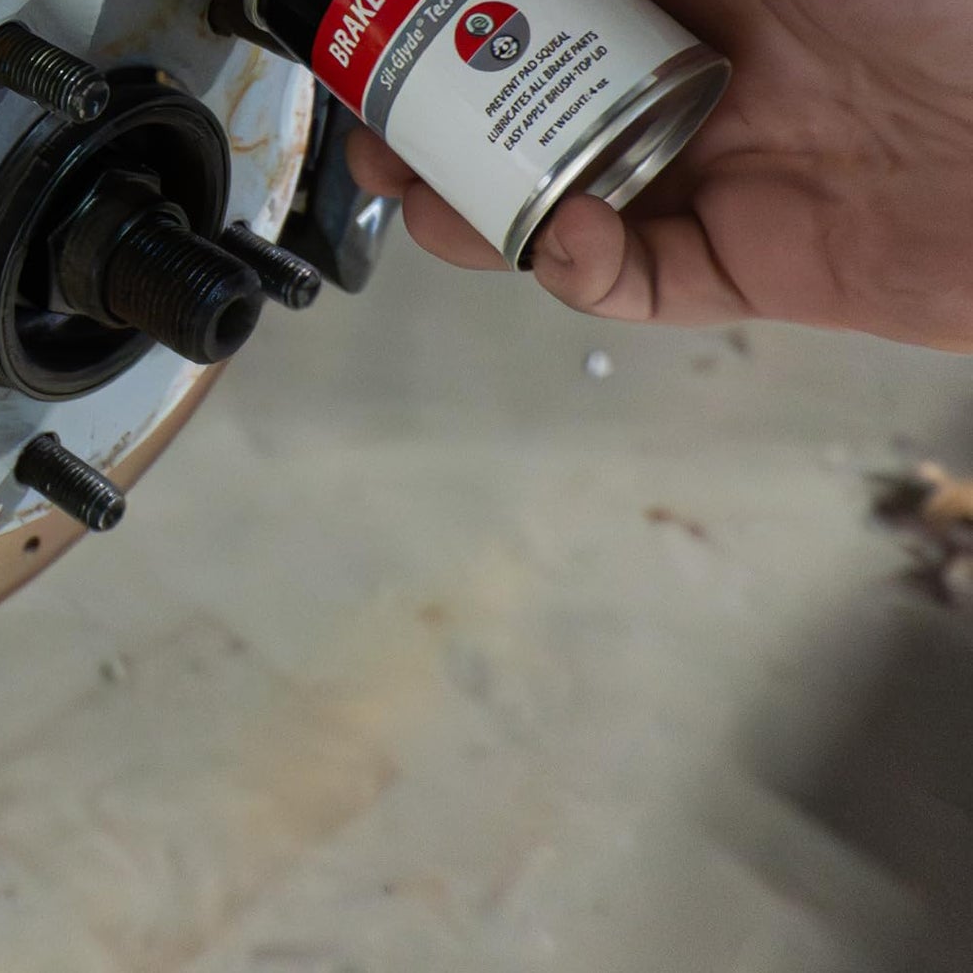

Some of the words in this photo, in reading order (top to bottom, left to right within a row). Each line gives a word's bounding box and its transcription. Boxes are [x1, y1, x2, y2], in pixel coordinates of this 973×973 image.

[485, 75, 521, 117] PREVENT
[518, 59, 538, 80] PAD
[535, 31, 571, 64] SQUEAL
[487, 91, 532, 143] LUBRICATES
[529, 77, 547, 96] ALL
[542, 50, 574, 80] BRAKE
[570, 30, 599, 55] PARTS
[503, 126, 525, 151] EASY
[522, 99, 547, 131] APPLY
[545, 57, 592, 104] BRUSH-TOP
[589, 45, 608, 62] LID
[538, 126, 557, 147] NET
[553, 93, 592, 130] WEIGHT:
[589, 87, 598, 95] 4
